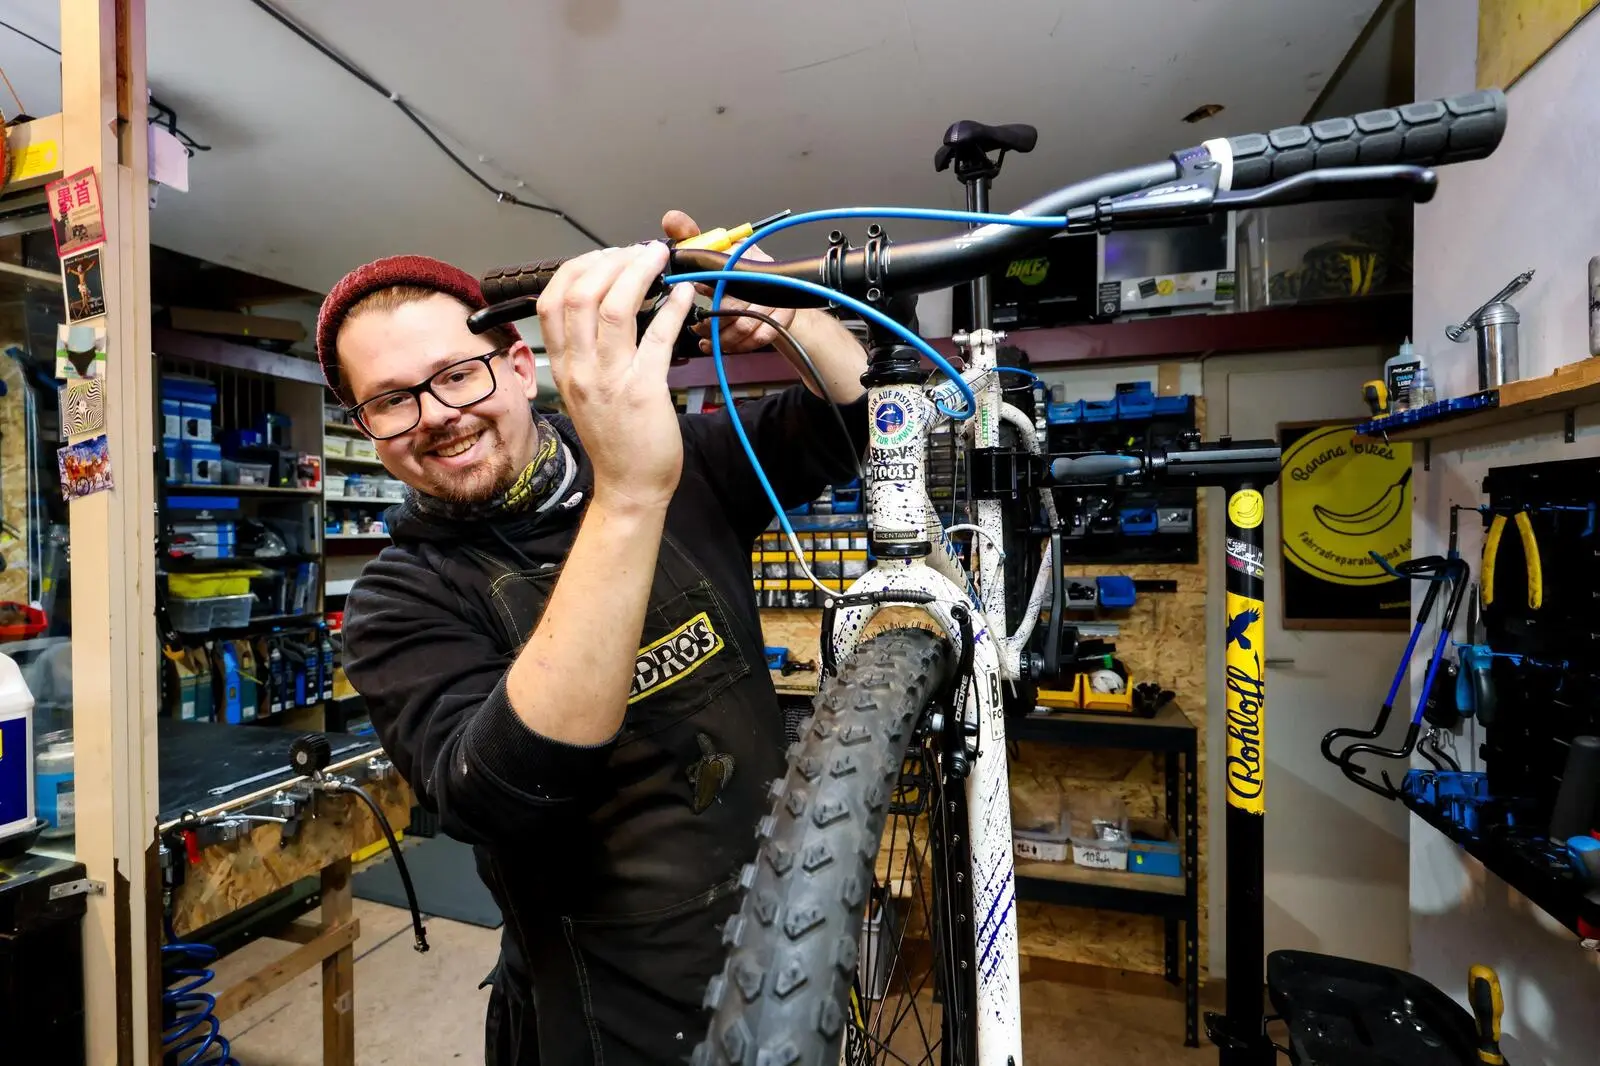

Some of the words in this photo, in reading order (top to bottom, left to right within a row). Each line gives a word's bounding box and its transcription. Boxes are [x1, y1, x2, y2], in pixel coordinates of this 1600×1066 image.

[870, 399, 879, 416] FAIR
[878, 390, 893, 401] AUF
[894, 391, 914, 414] PISTEN
[876, 434, 889, 445] ZUR
[873, 464, 915, 481] TOOLS
[1291, 446, 1348, 481] Banana
[954, 674, 969, 722] DEORE
[1226, 650, 1265, 799] Rohloff
